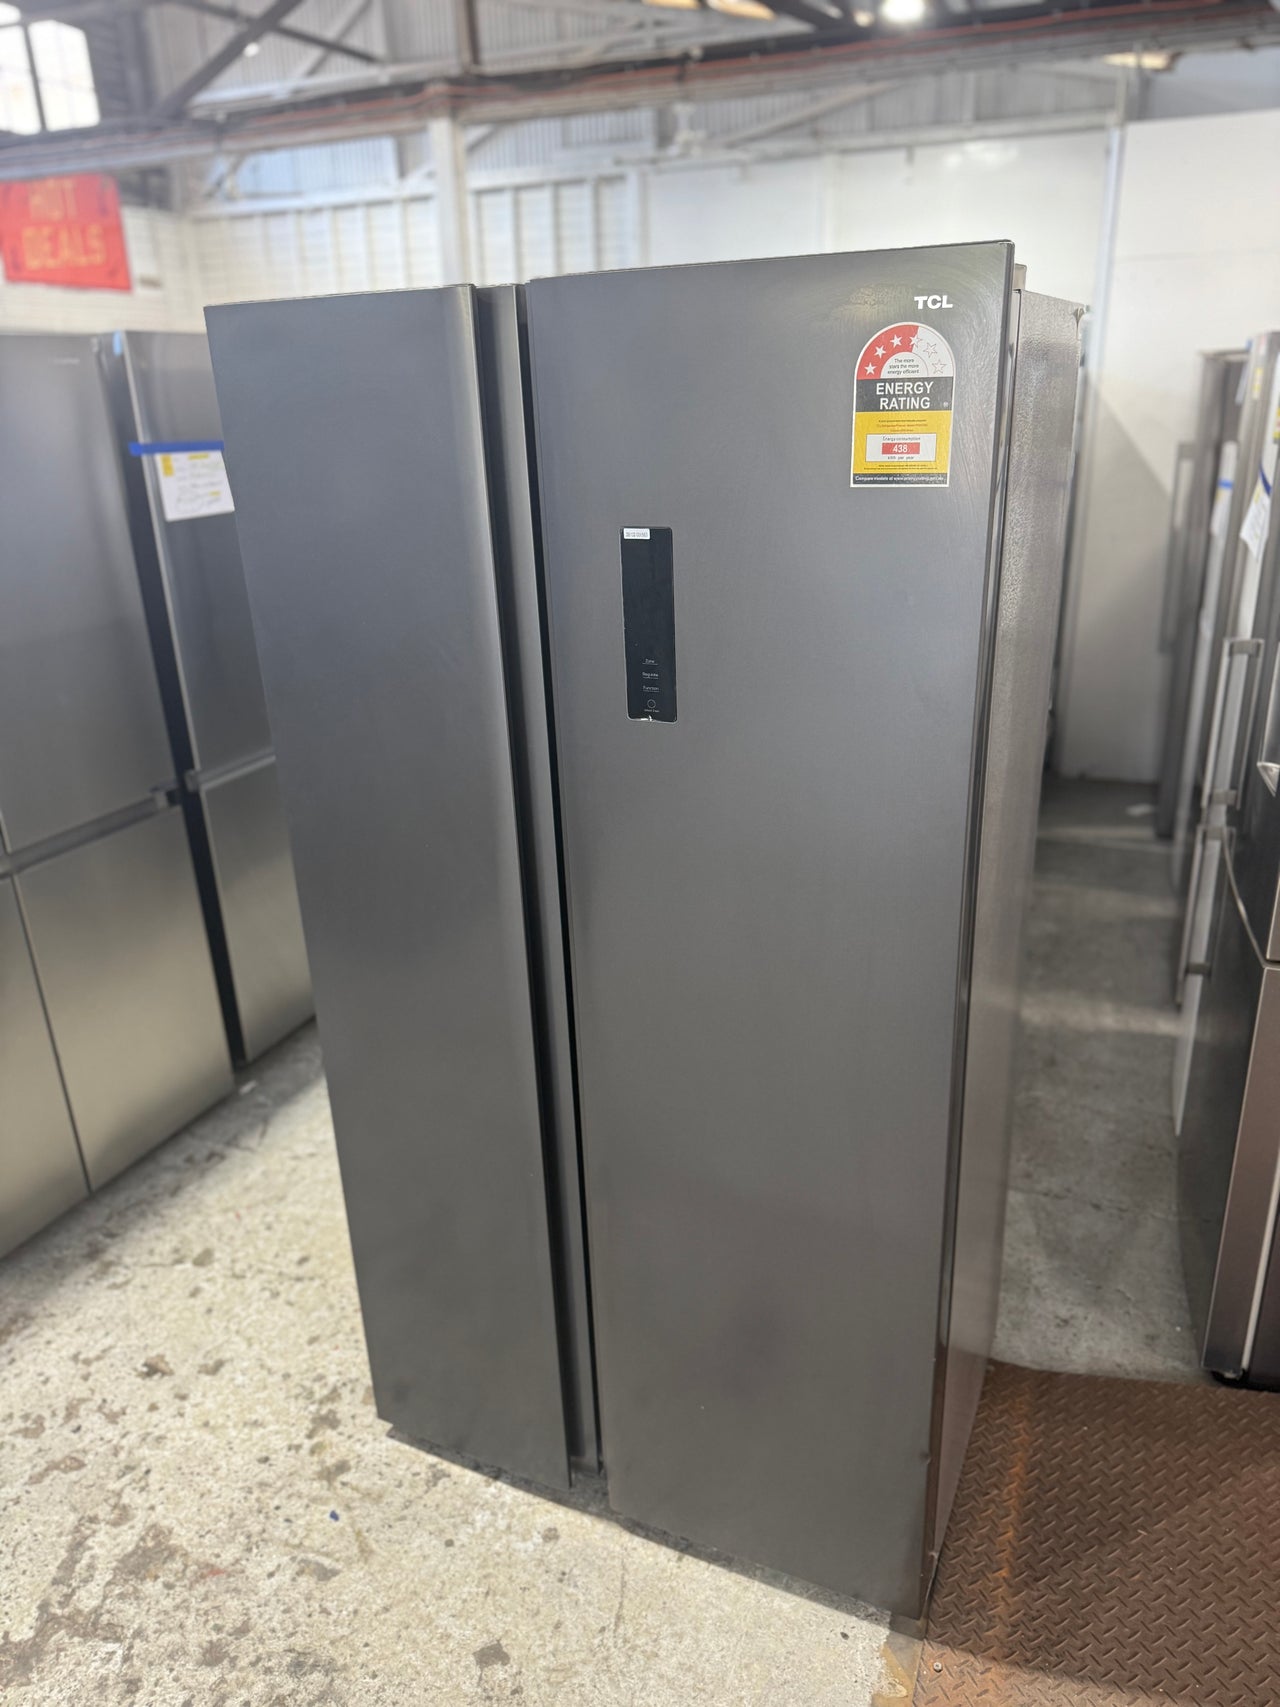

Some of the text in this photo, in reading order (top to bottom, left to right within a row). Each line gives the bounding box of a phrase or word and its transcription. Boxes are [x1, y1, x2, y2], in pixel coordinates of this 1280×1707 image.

[28, 178, 78, 222] HOT
[22, 224, 107, 271] DEALS
[914, 295, 953, 309] TCL
[876, 381, 934, 395] ENERGY
[879, 397, 931, 410] RATING
[892, 444, 908, 453] 438
